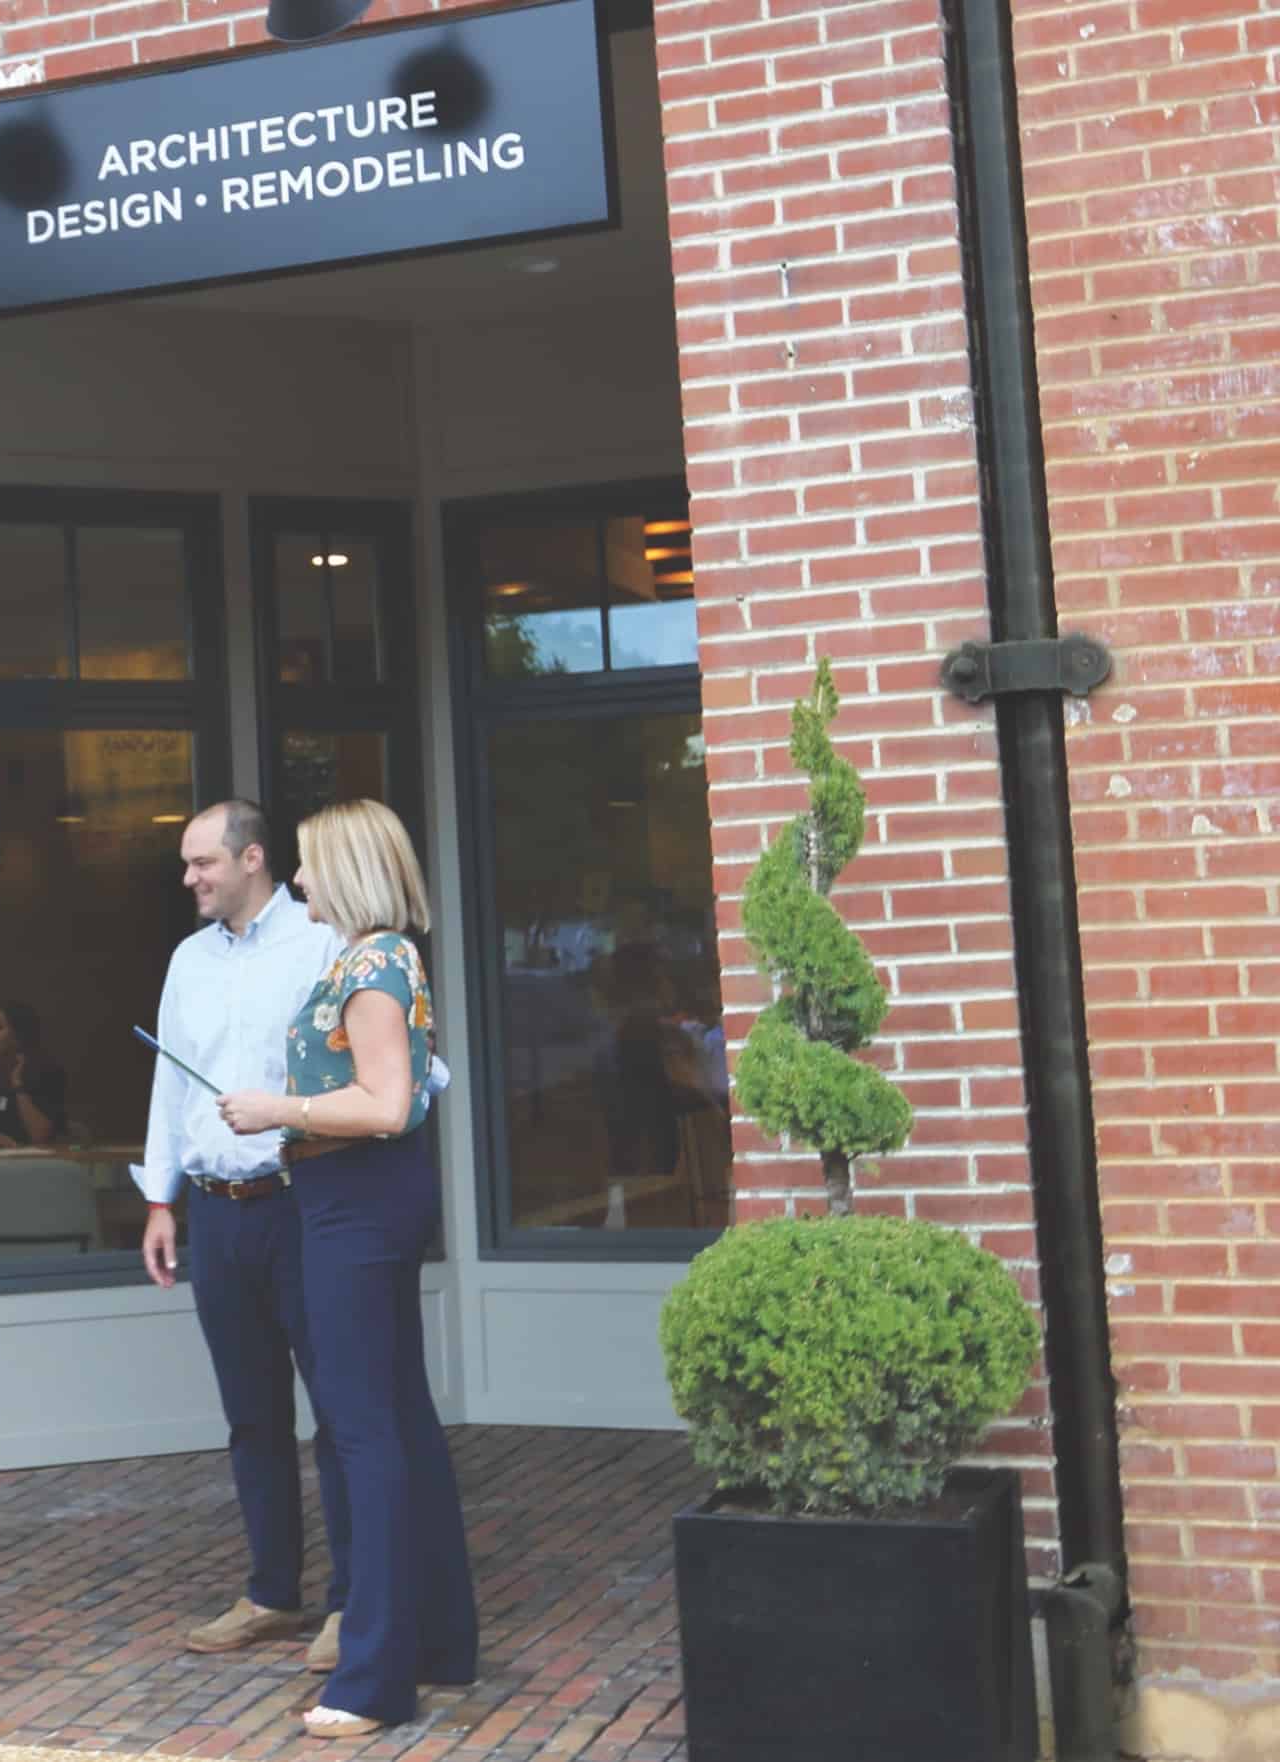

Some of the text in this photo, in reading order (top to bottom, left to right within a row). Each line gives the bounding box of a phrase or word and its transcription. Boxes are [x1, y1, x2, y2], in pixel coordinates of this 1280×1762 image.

[98, 90, 438, 181] ARCHITECTURE
[26, 132, 526, 245] DESIGN REMODELING
